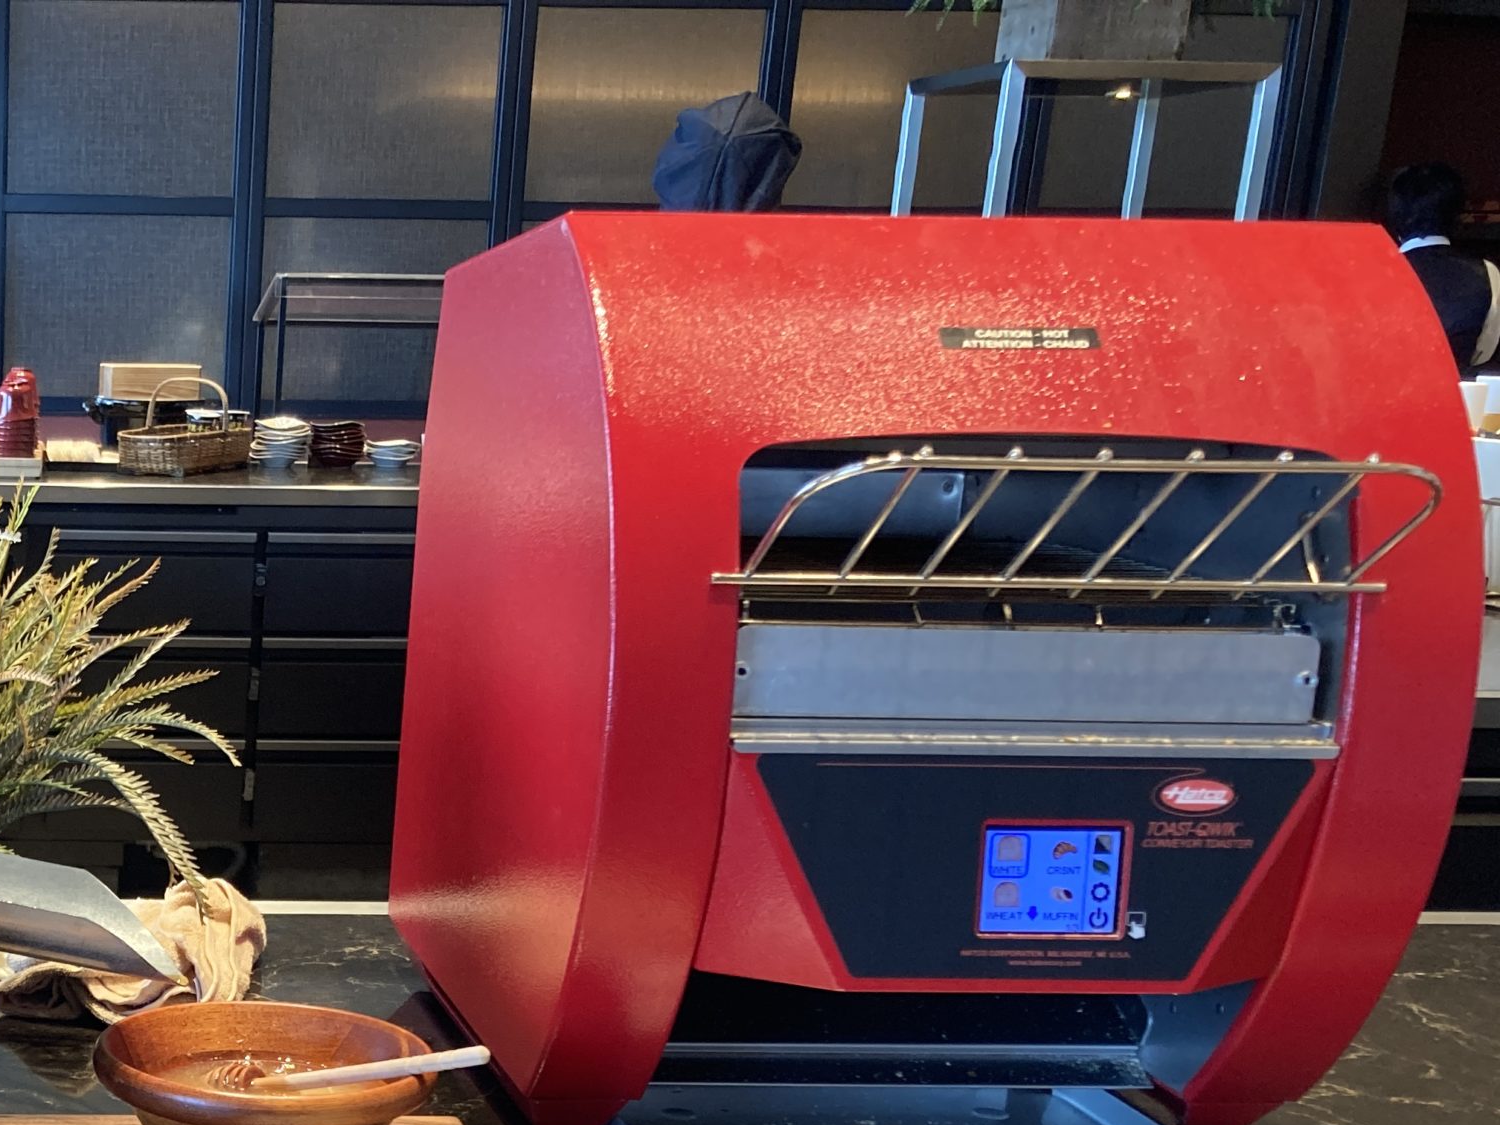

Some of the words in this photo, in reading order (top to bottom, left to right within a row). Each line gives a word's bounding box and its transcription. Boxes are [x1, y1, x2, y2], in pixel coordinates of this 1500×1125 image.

[974, 329, 1033, 338] CAUTION
[1042, 329, 1069, 338] HOT
[962, 339, 1034, 349] ATTENTION
[1042, 339, 1090, 349] CHAUD
[985, 911, 1023, 921] WHEAT
[1043, 912, 1078, 921] MUFFIN
